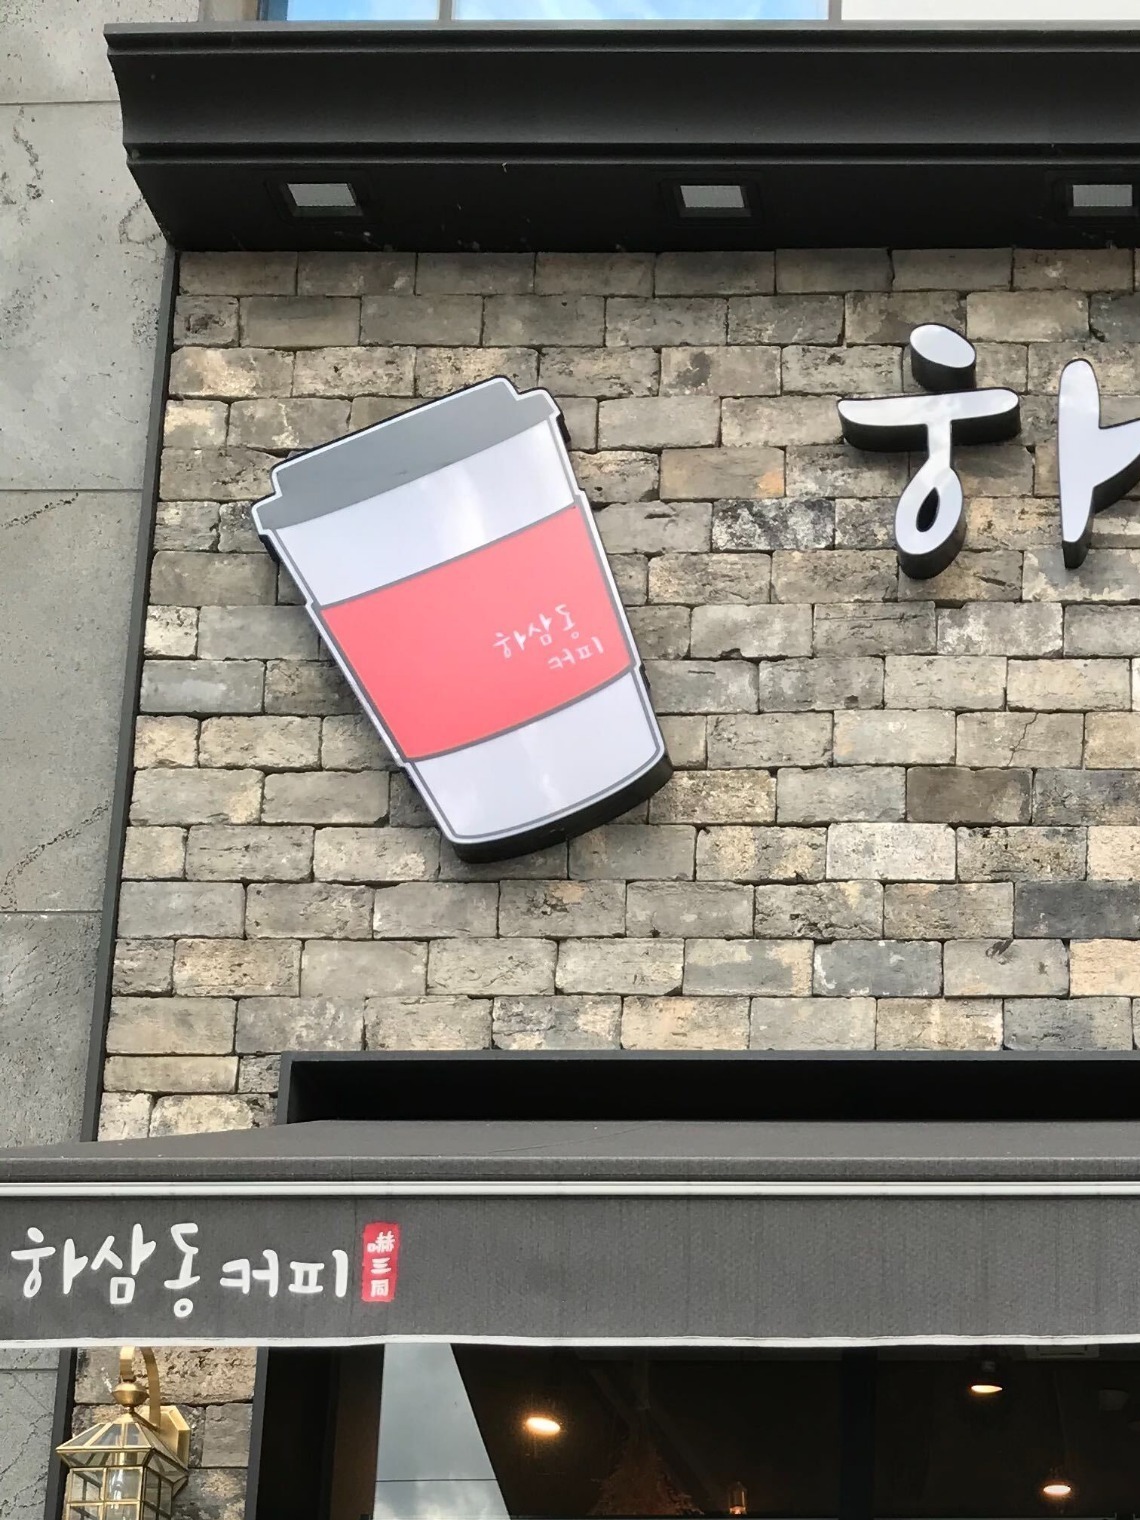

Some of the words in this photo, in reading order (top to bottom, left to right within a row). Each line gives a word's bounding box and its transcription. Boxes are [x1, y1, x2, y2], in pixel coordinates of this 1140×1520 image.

[493, 604, 579, 658] 하삼동
[548, 637, 604, 669] 커피
[11, 1223, 200, 1317] 하삼동
[220, 1249, 348, 1298] 커피
